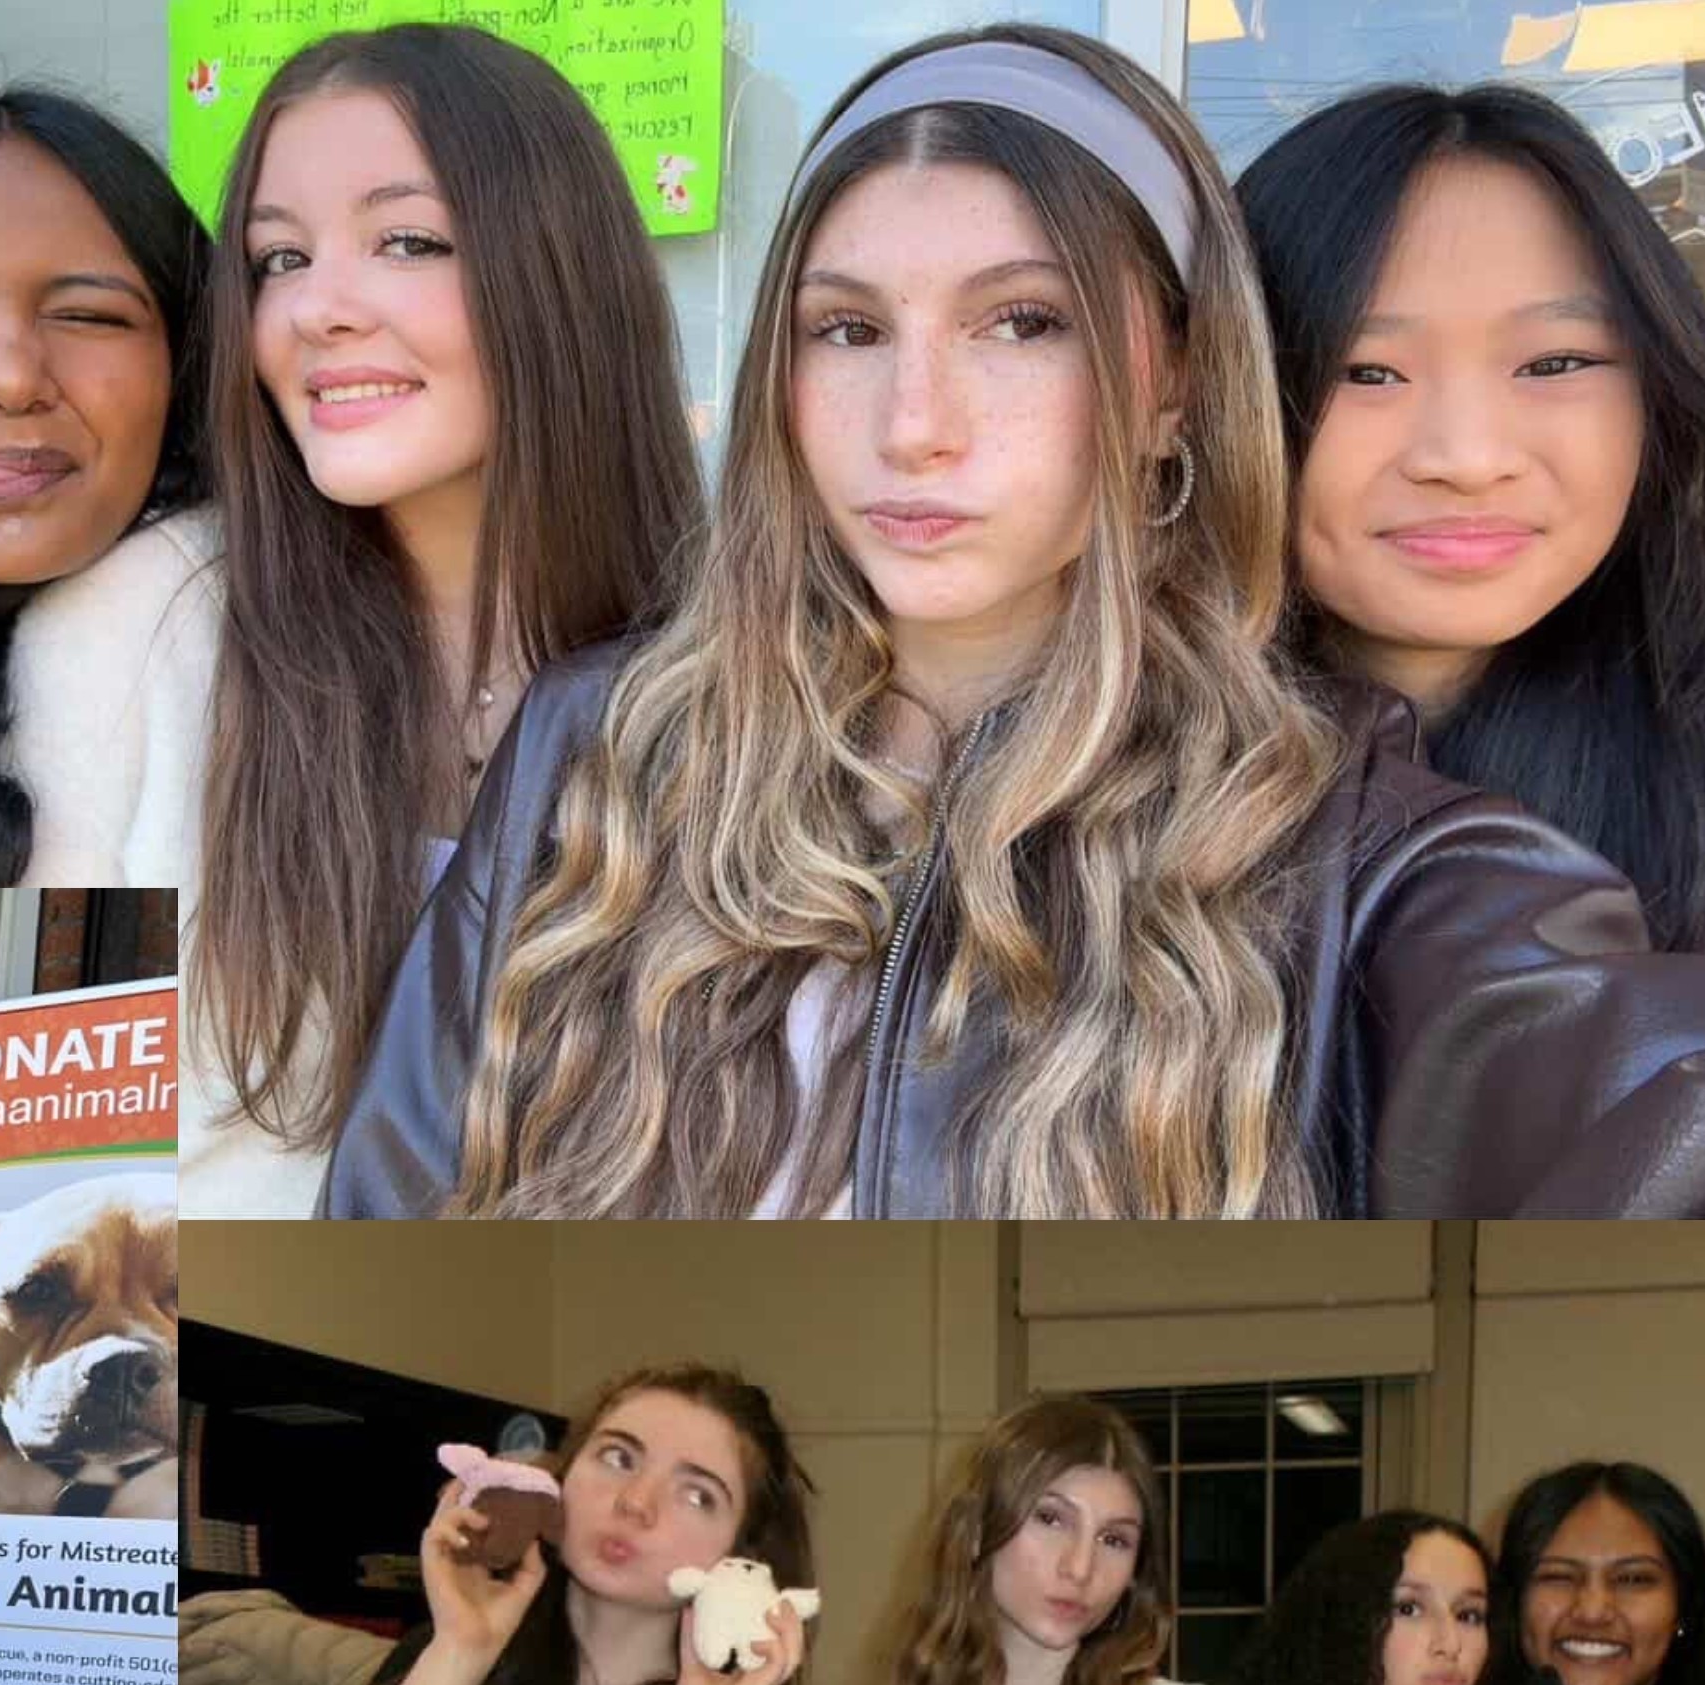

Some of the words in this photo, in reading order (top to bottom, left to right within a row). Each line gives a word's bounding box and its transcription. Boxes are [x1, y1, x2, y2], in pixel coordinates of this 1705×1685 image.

[15, 1538, 53, 1563] for
[6, 1575, 179, 1618] Animal
[45, 1651, 125, 1670] non-profit
